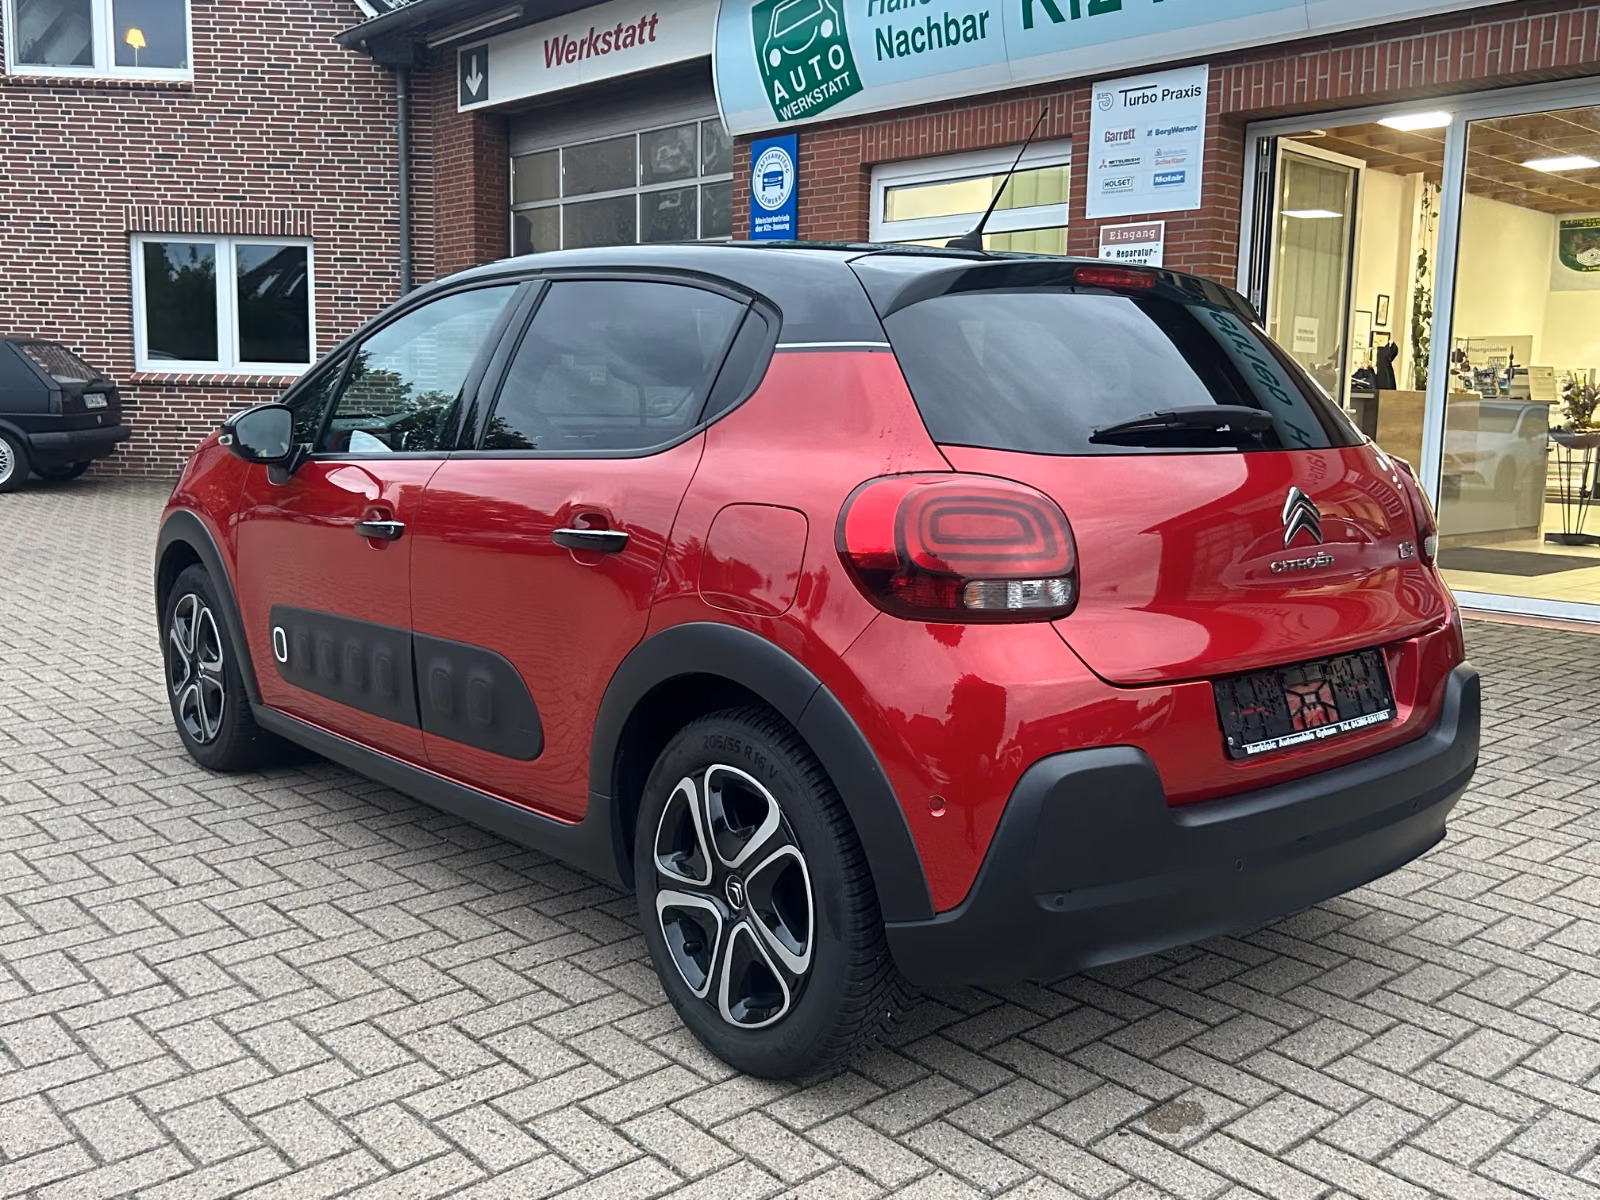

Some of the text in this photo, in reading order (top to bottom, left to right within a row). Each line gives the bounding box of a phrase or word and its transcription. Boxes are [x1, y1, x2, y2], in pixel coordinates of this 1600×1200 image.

[544, 12, 659, 68] Werkstatt
[876, 11, 989, 61] Nachbar
[774, 45, 845, 104] AUTO
[780, 72, 850, 121] WERKSTATT
[1119, 85, 1202, 107] Turbo Praxis
[1105, 125, 1198, 142] Garrett BorgWarner
[1105, 174, 1183, 187] HOLSET Motair
[1109, 229, 1156, 240] Eingang
[1116, 248, 1157, 258] Reparatur-
[1271, 551, 1334, 572] CITROËN
[703, 735, 741, 753] 205/55
